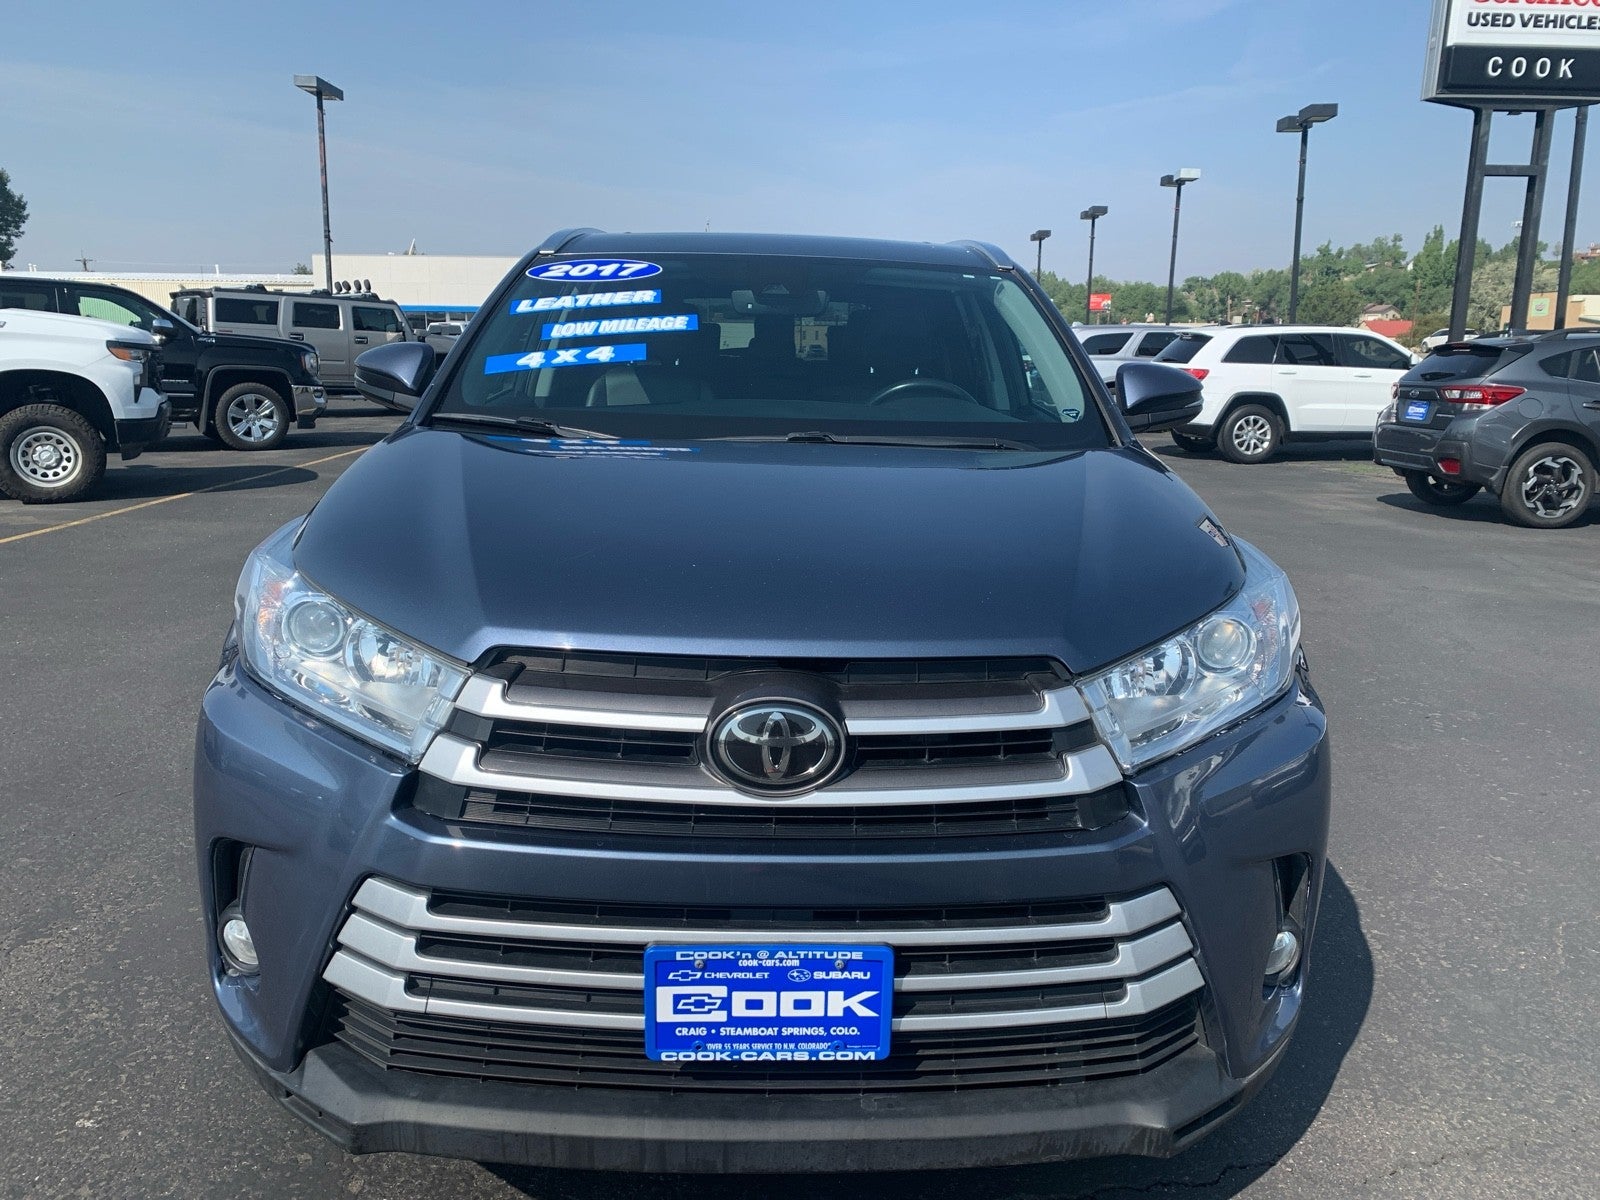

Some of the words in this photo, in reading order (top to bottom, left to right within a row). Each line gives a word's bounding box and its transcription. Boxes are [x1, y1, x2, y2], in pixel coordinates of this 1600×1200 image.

[1467, 12, 1516, 28] USED
[1487, 56, 1576, 79] COOK
[538, 263, 649, 277] 2017
[516, 290, 657, 312] LEATHER
[550, 321, 600, 339] LOW
[598, 315, 690, 335] MILEAGE
[776, 951, 863, 960] ALTITUDE
[738, 959, 800, 967] cook-cars.com
[813, 971, 871, 980] SUBARU
[656, 985, 880, 1022] COOK
[675, 1027, 708, 1036] CRAIG
[719, 1027, 779, 1036] STEAMBOAT
[781, 1027, 827, 1037] SPRINGS,
[830, 1027, 861, 1036] COLO.
[660, 1051, 876, 1061] COOK-CARS.COM
